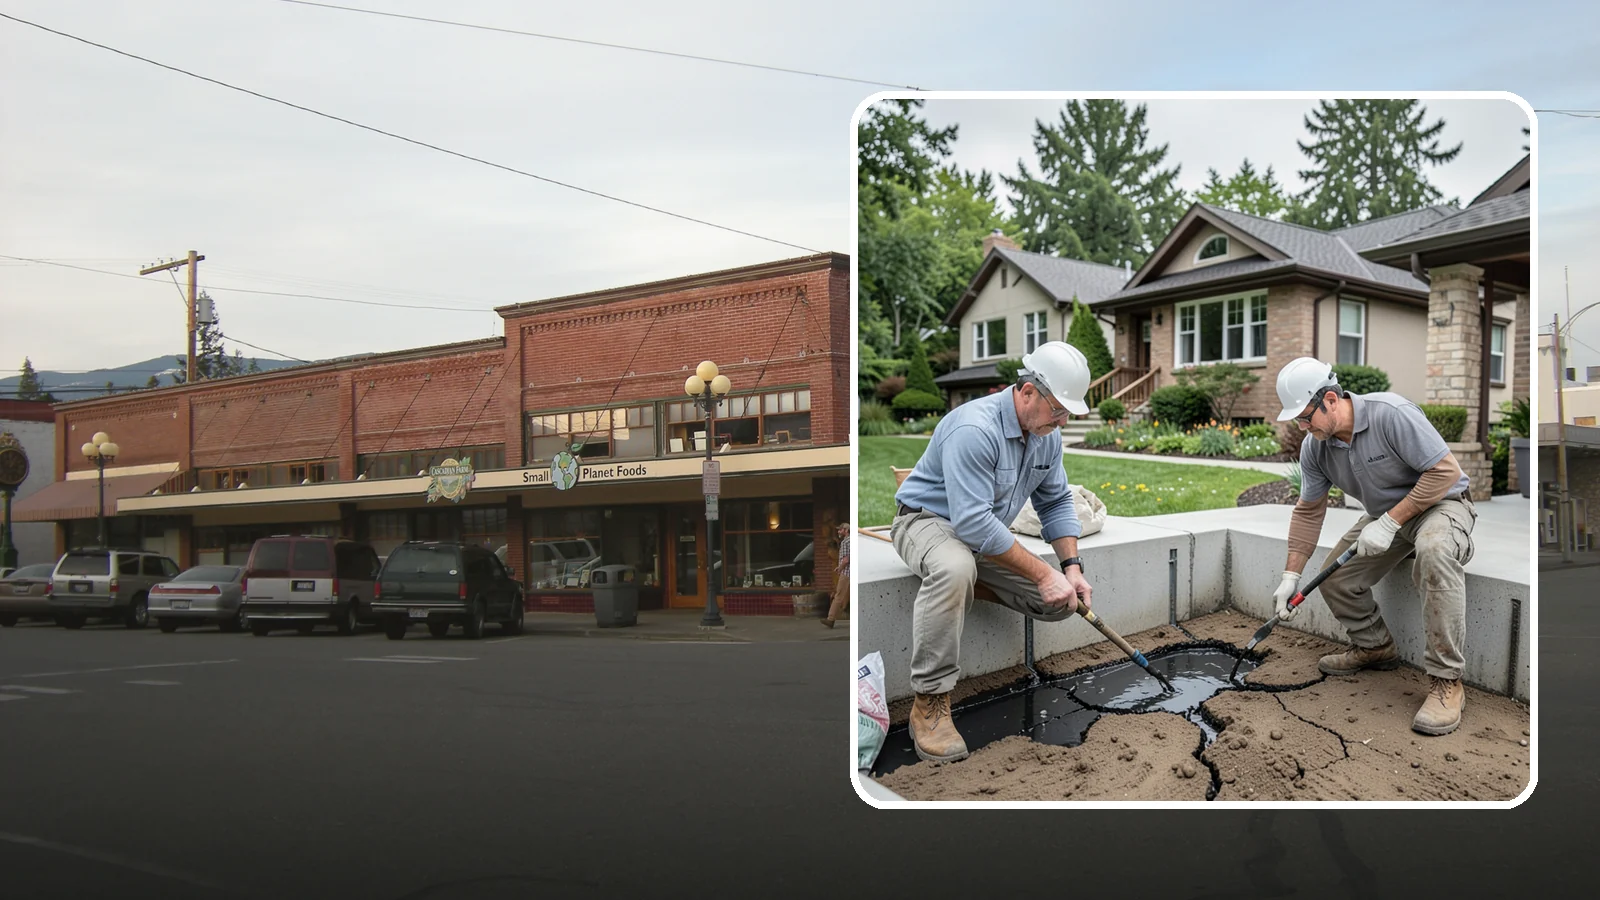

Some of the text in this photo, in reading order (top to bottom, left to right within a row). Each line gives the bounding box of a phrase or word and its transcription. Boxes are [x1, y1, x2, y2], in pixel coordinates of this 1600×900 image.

[523, 464, 647, 483] Small Planet Foods
